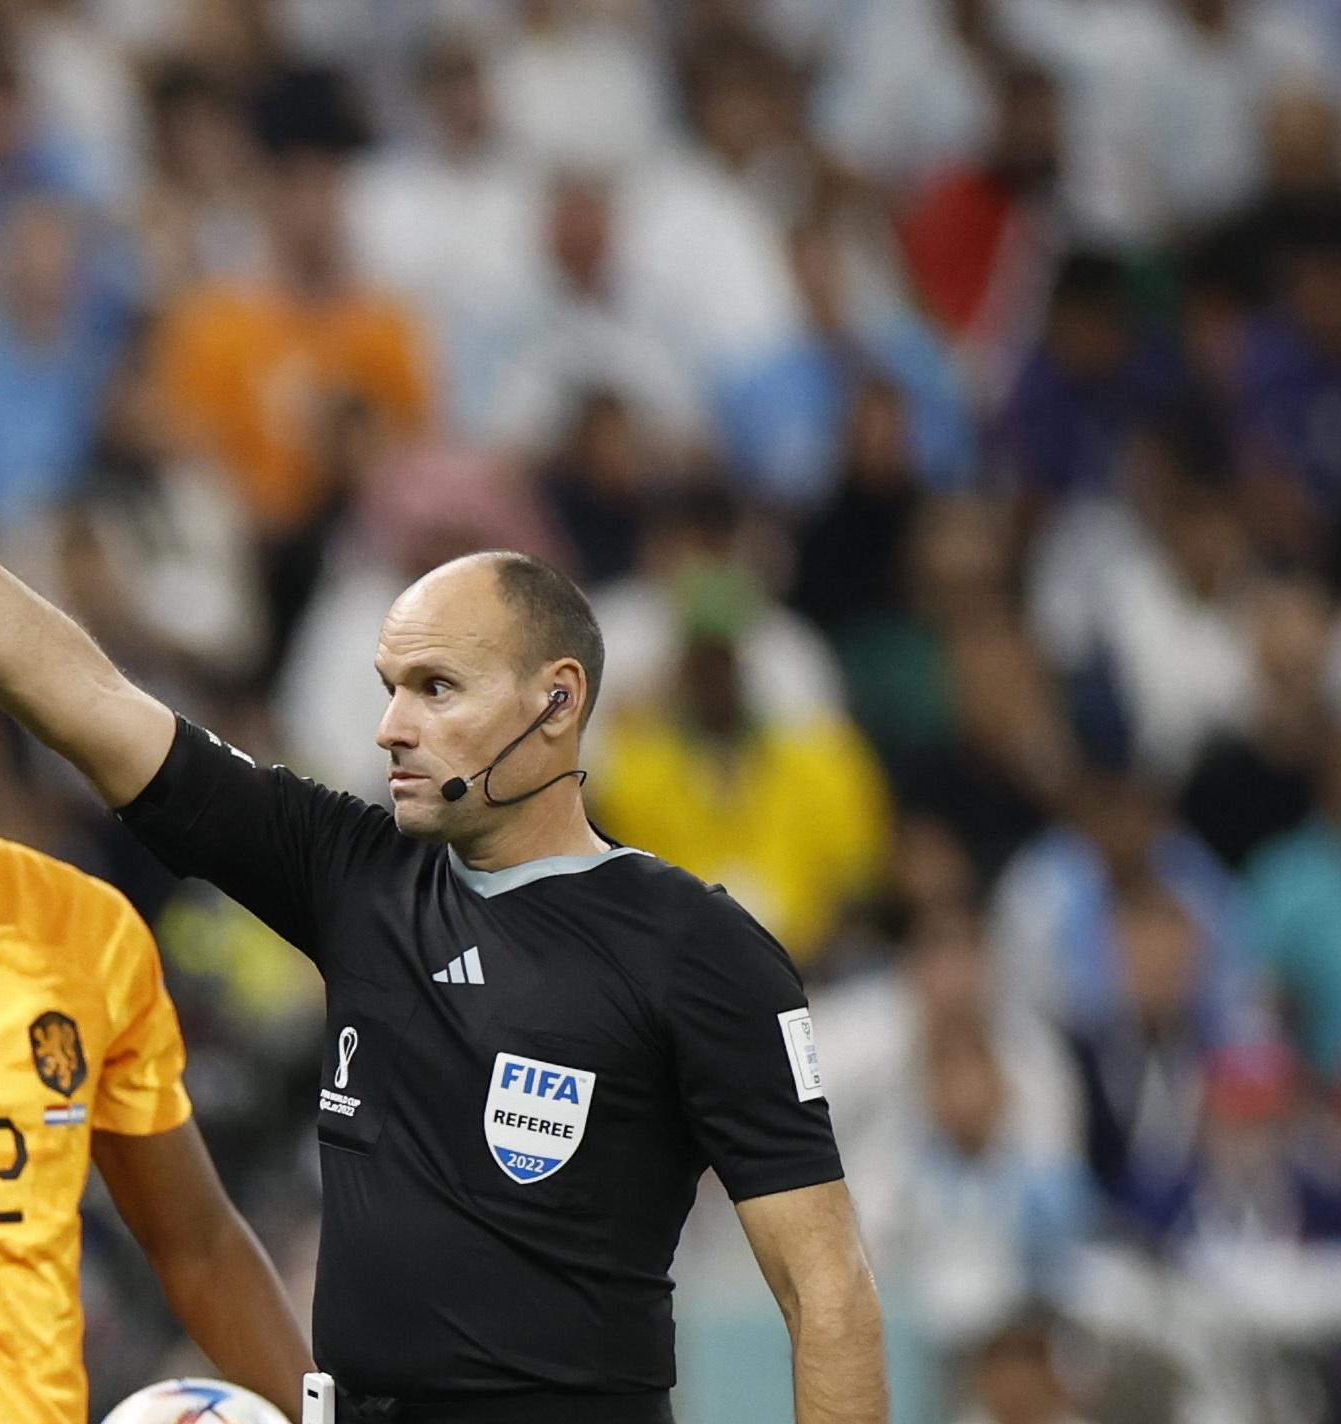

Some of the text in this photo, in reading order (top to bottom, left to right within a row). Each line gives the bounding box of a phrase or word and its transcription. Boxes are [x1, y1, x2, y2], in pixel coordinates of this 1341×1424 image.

[500, 1062, 579, 1105] FIFA
[493, 1109, 575, 1140] REFEREE
[506, 1153, 545, 1174] 2022
